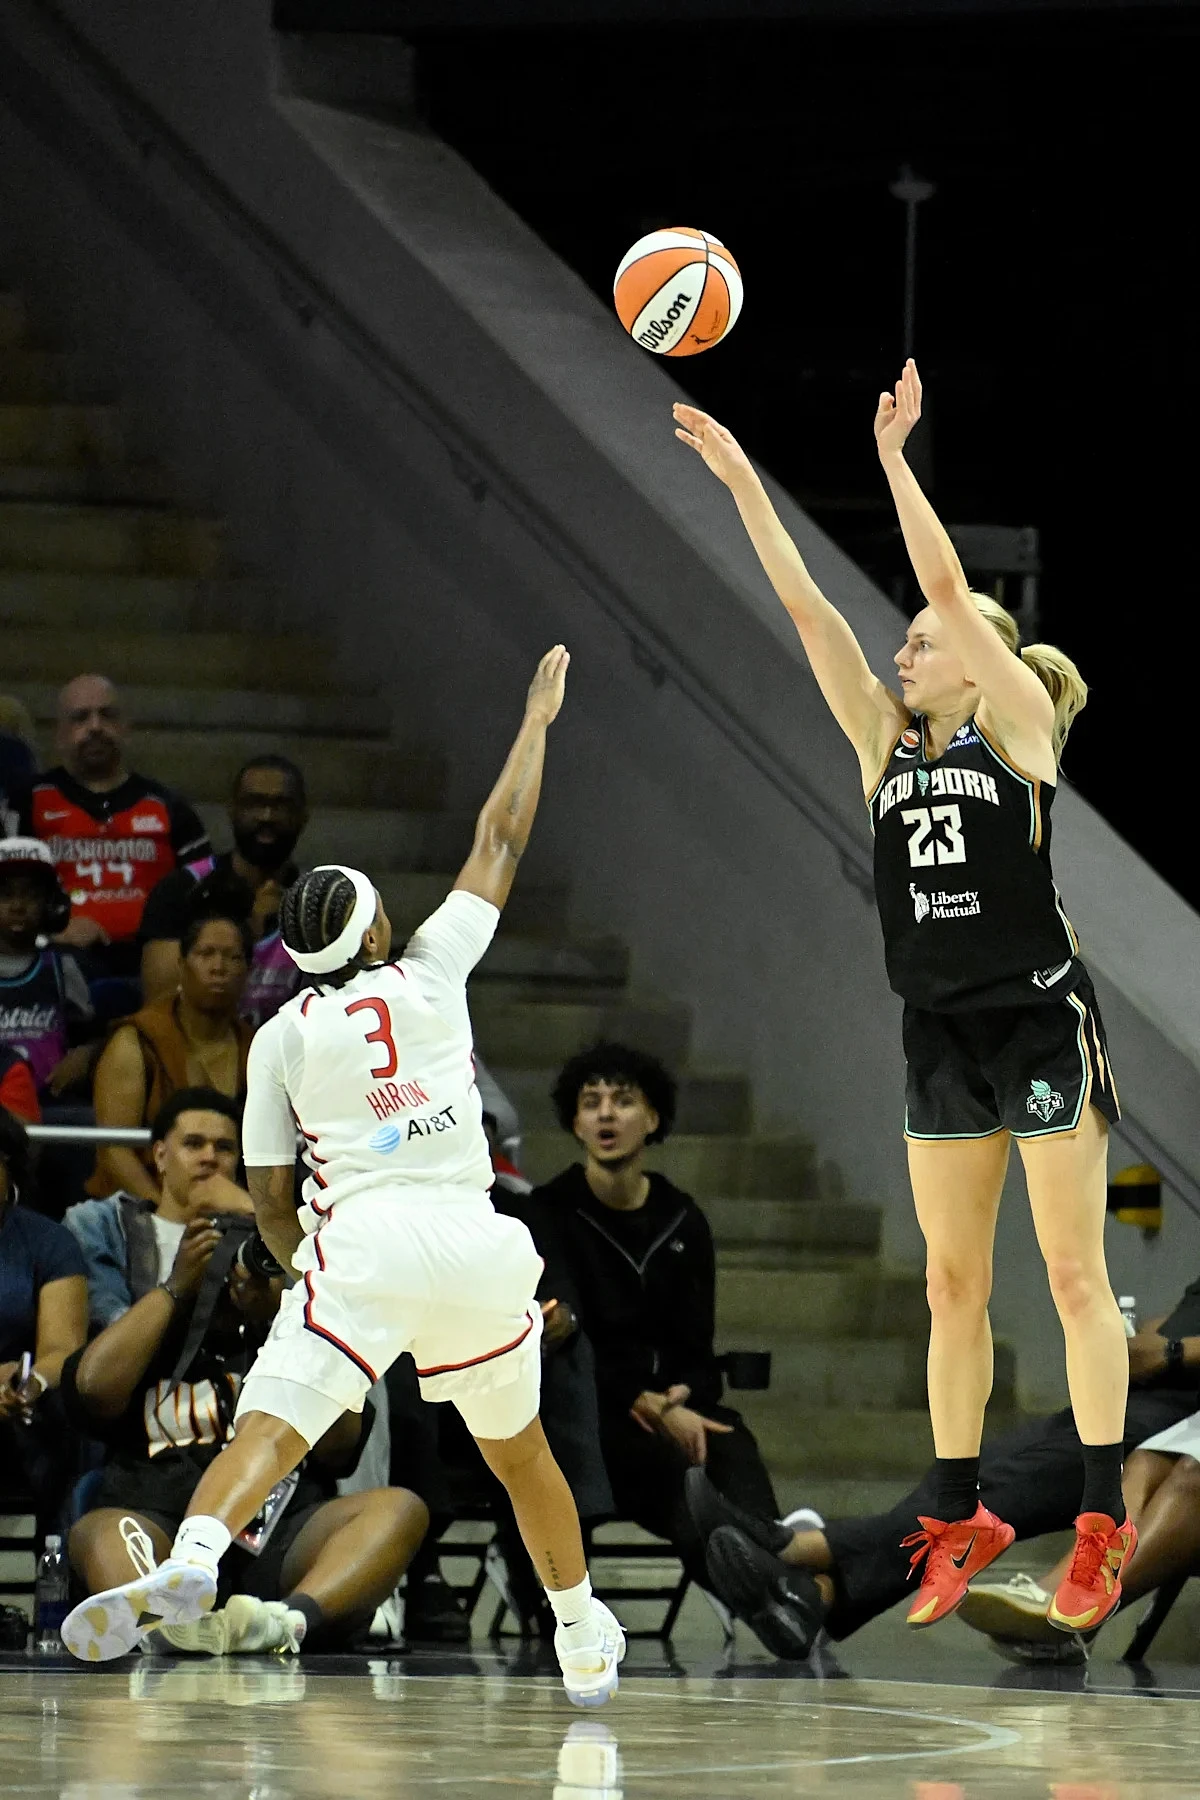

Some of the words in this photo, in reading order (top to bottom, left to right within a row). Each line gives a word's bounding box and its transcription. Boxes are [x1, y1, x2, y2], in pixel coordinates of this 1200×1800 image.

[638, 293, 692, 349] Wilson
[879, 772, 914, 820] NEW
[930, 767, 1000, 806] YORK
[900, 803, 967, 868] 23
[931, 890, 979, 907] Liberty
[931, 900, 981, 919] Mutual
[344, 997, 398, 1078] 3
[407, 1105, 457, 1141] AT&T
